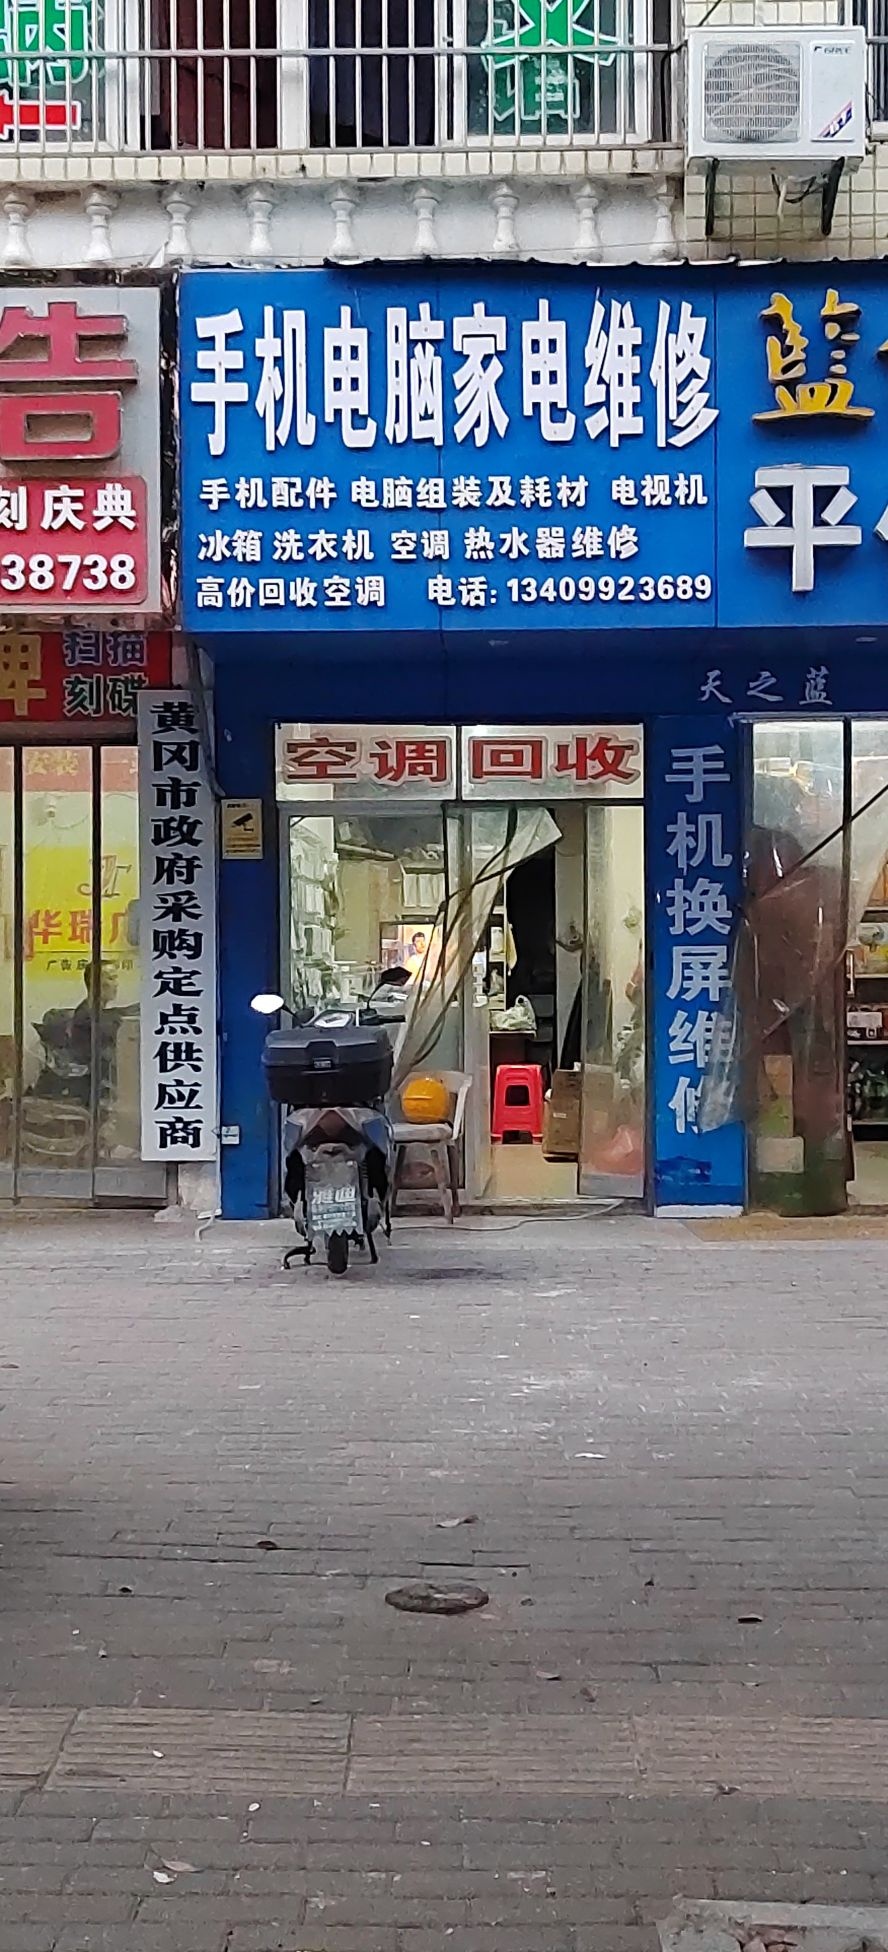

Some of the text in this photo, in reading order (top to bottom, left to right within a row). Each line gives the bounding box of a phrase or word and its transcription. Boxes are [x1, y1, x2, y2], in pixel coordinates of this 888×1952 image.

[0, 302, 139, 460] 告
[191, 296, 720, 456] 手机电脑家电维修
[200, 473, 708, 511] 手机配件 电脑组装及耗材 电视机
[198, 524, 639, 562] 冰箱 洗衣机 空调 热水器维修
[196, 575, 386, 609] 高价回收空调
[62, 630, 147, 667] 扫描
[150, 701, 205, 1150] 黄冈市政府采购定点供应商
